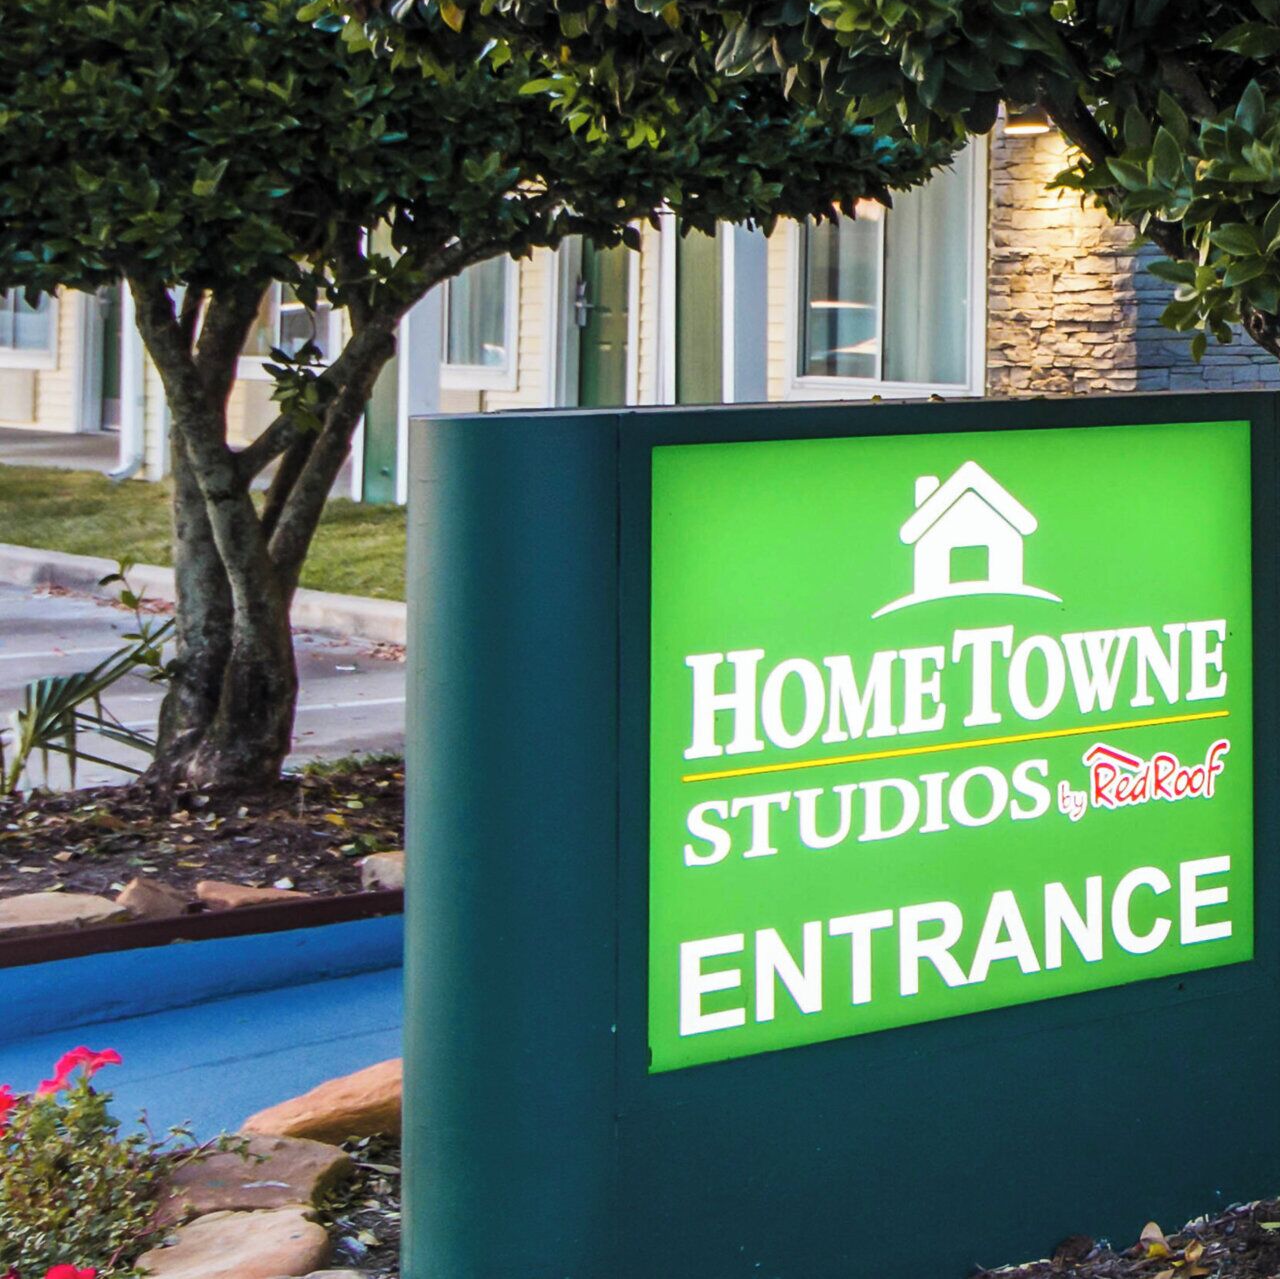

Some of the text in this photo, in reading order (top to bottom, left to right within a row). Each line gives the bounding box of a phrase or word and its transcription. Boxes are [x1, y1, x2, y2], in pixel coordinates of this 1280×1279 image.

[683, 619, 1228, 760] HOMETOWNE
[683, 759, 1052, 867] STUDIOS
[1058, 781, 1087, 821] by
[679, 855, 1232, 1036] ENTRANCE
